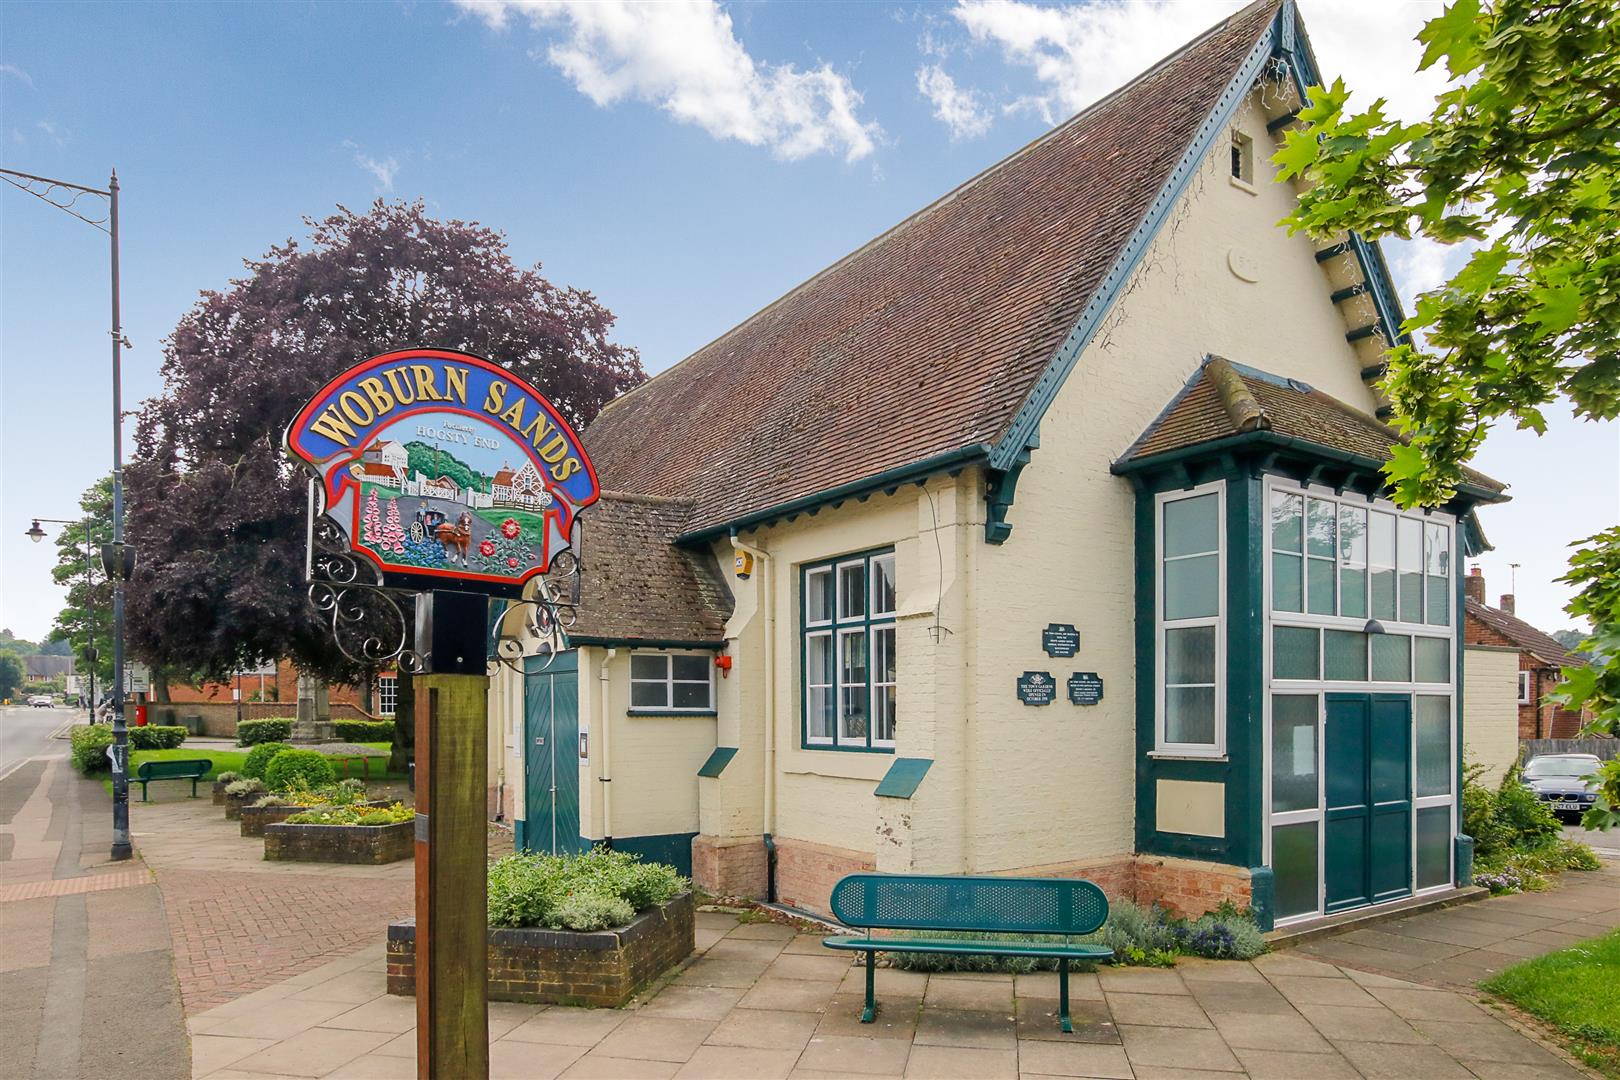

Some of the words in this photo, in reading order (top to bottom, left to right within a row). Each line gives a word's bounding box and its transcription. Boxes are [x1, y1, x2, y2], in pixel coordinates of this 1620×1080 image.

[310, 364, 469, 448] WOBURN
[483, 379, 582, 482] SANDS
[416, 425, 469, 445] HOGSTY
[474, 436, 500, 450] END
